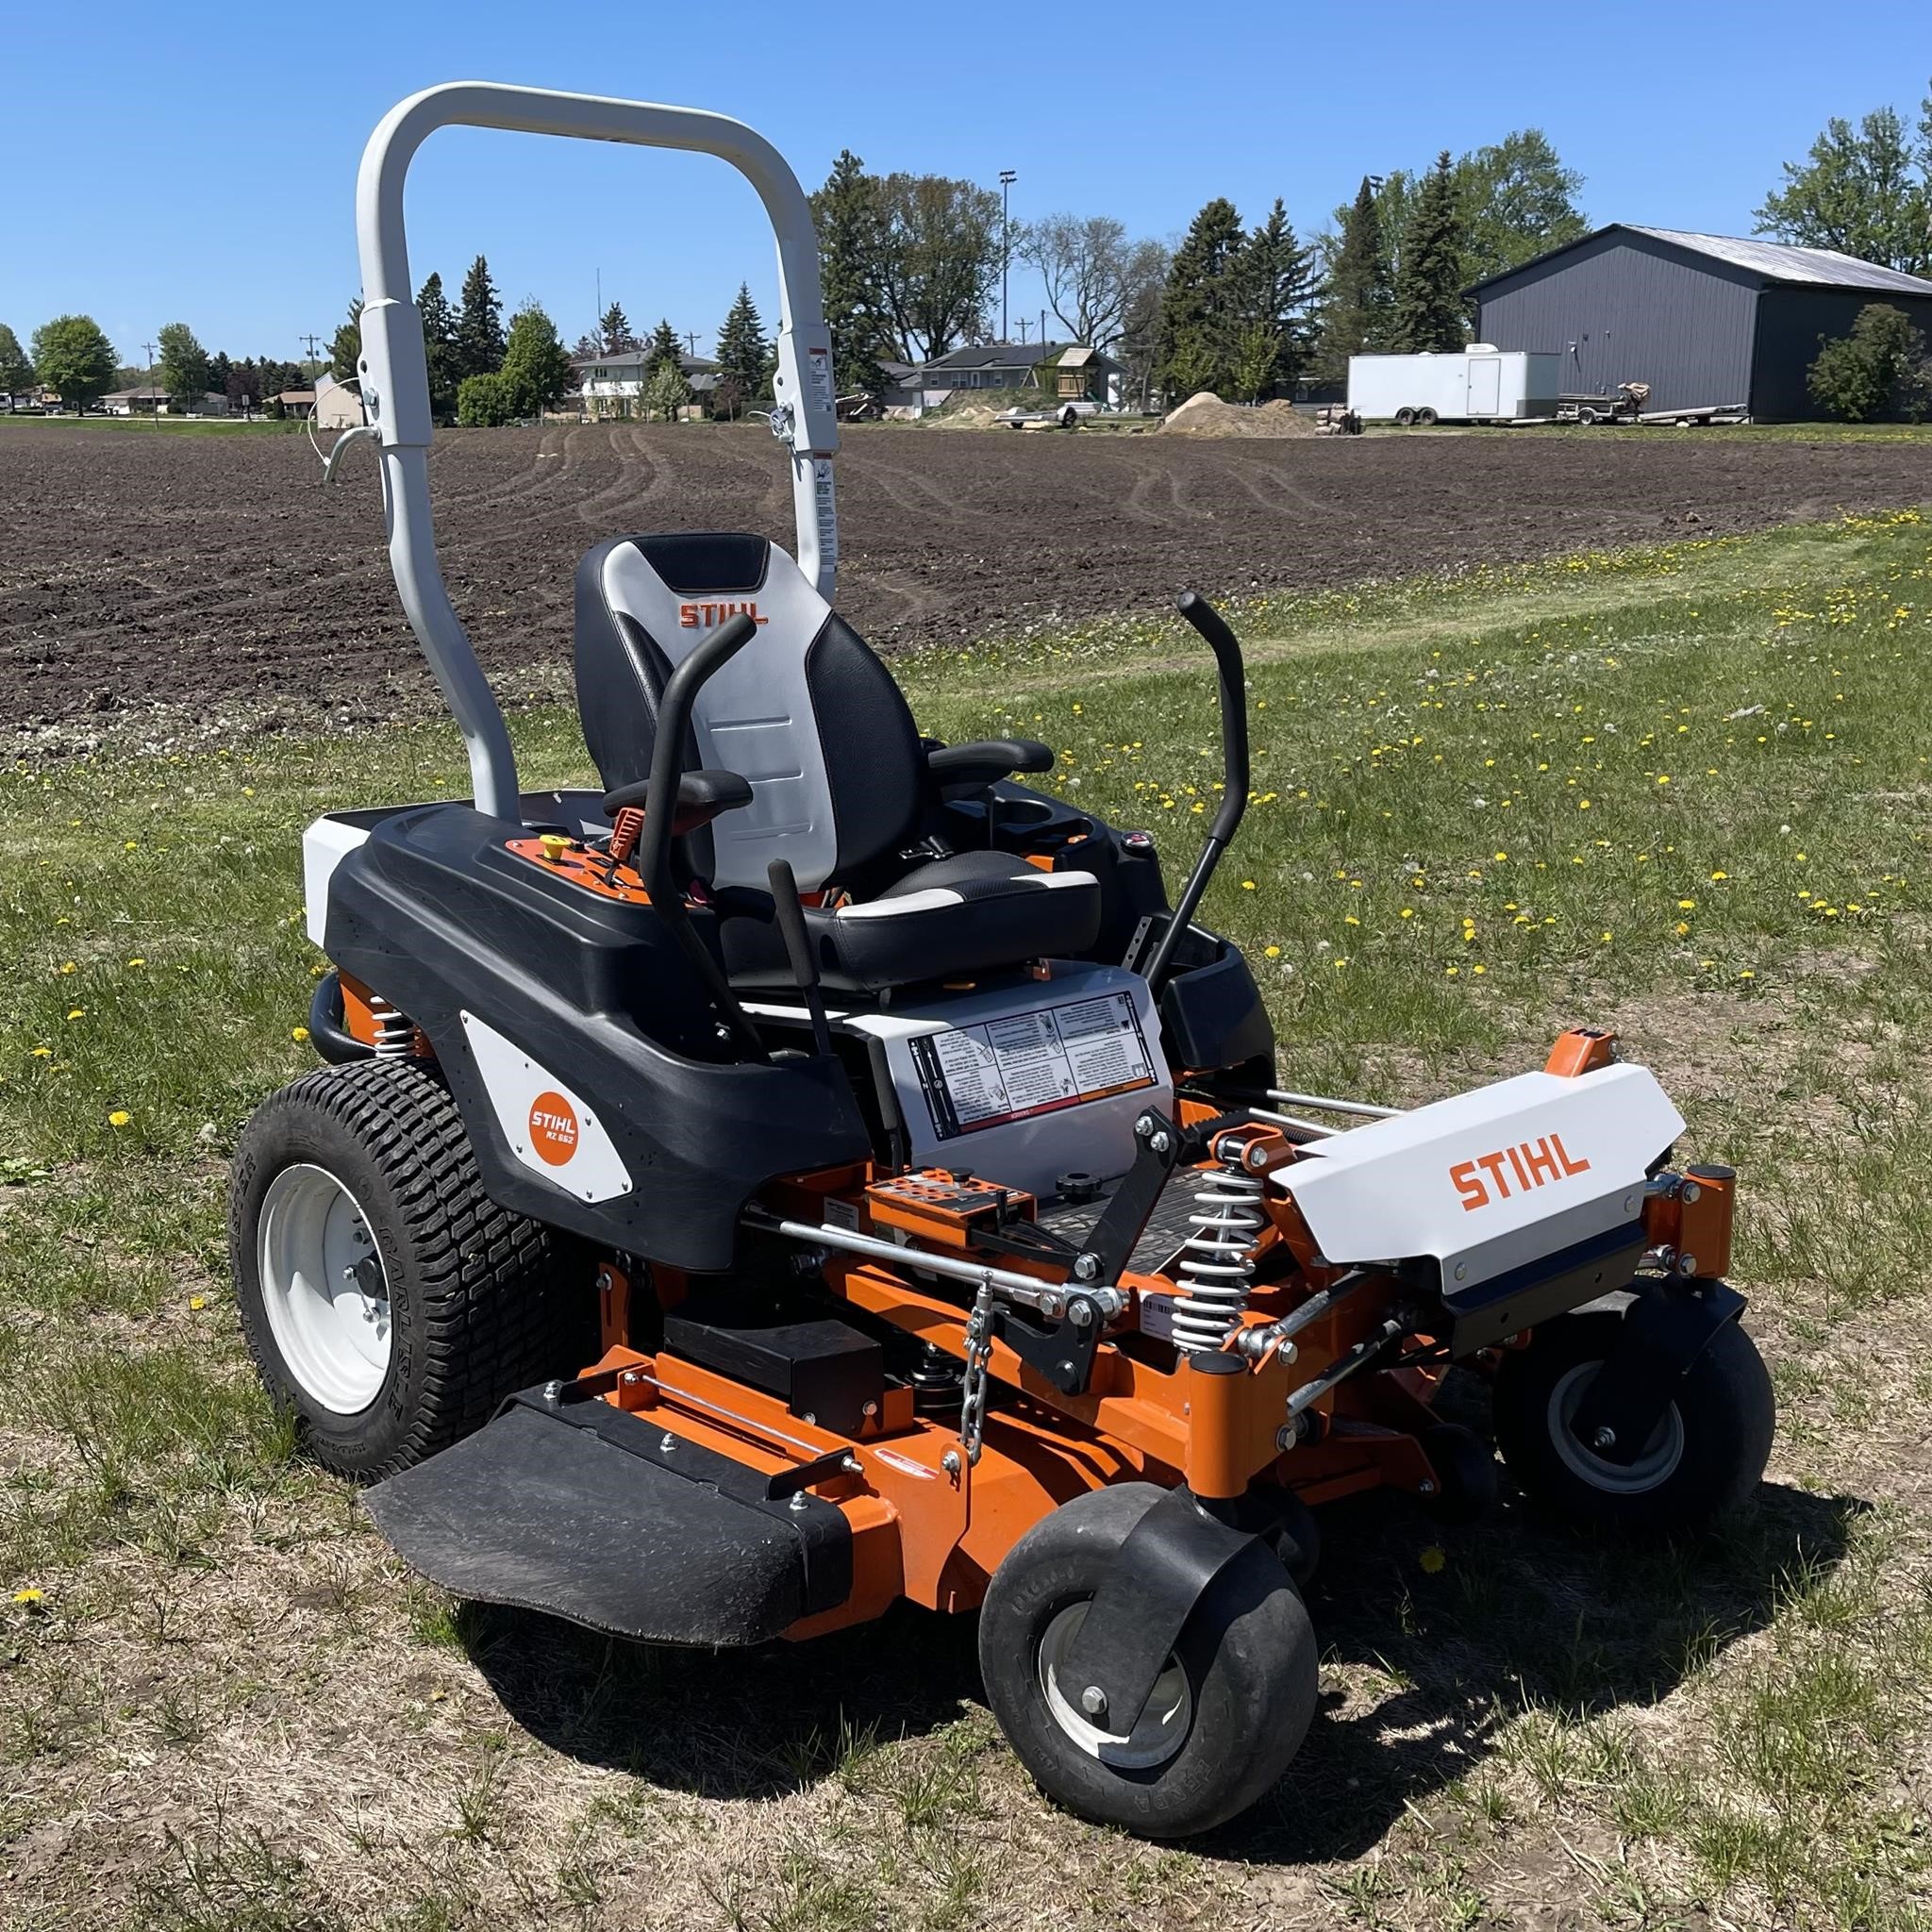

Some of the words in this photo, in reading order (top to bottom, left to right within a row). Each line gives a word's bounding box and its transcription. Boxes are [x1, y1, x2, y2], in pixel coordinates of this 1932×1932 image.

[531, 1110, 576, 1135] STIHL
[545, 1130, 558, 1141] RZ
[1449, 1133, 1591, 1212] STIHL
